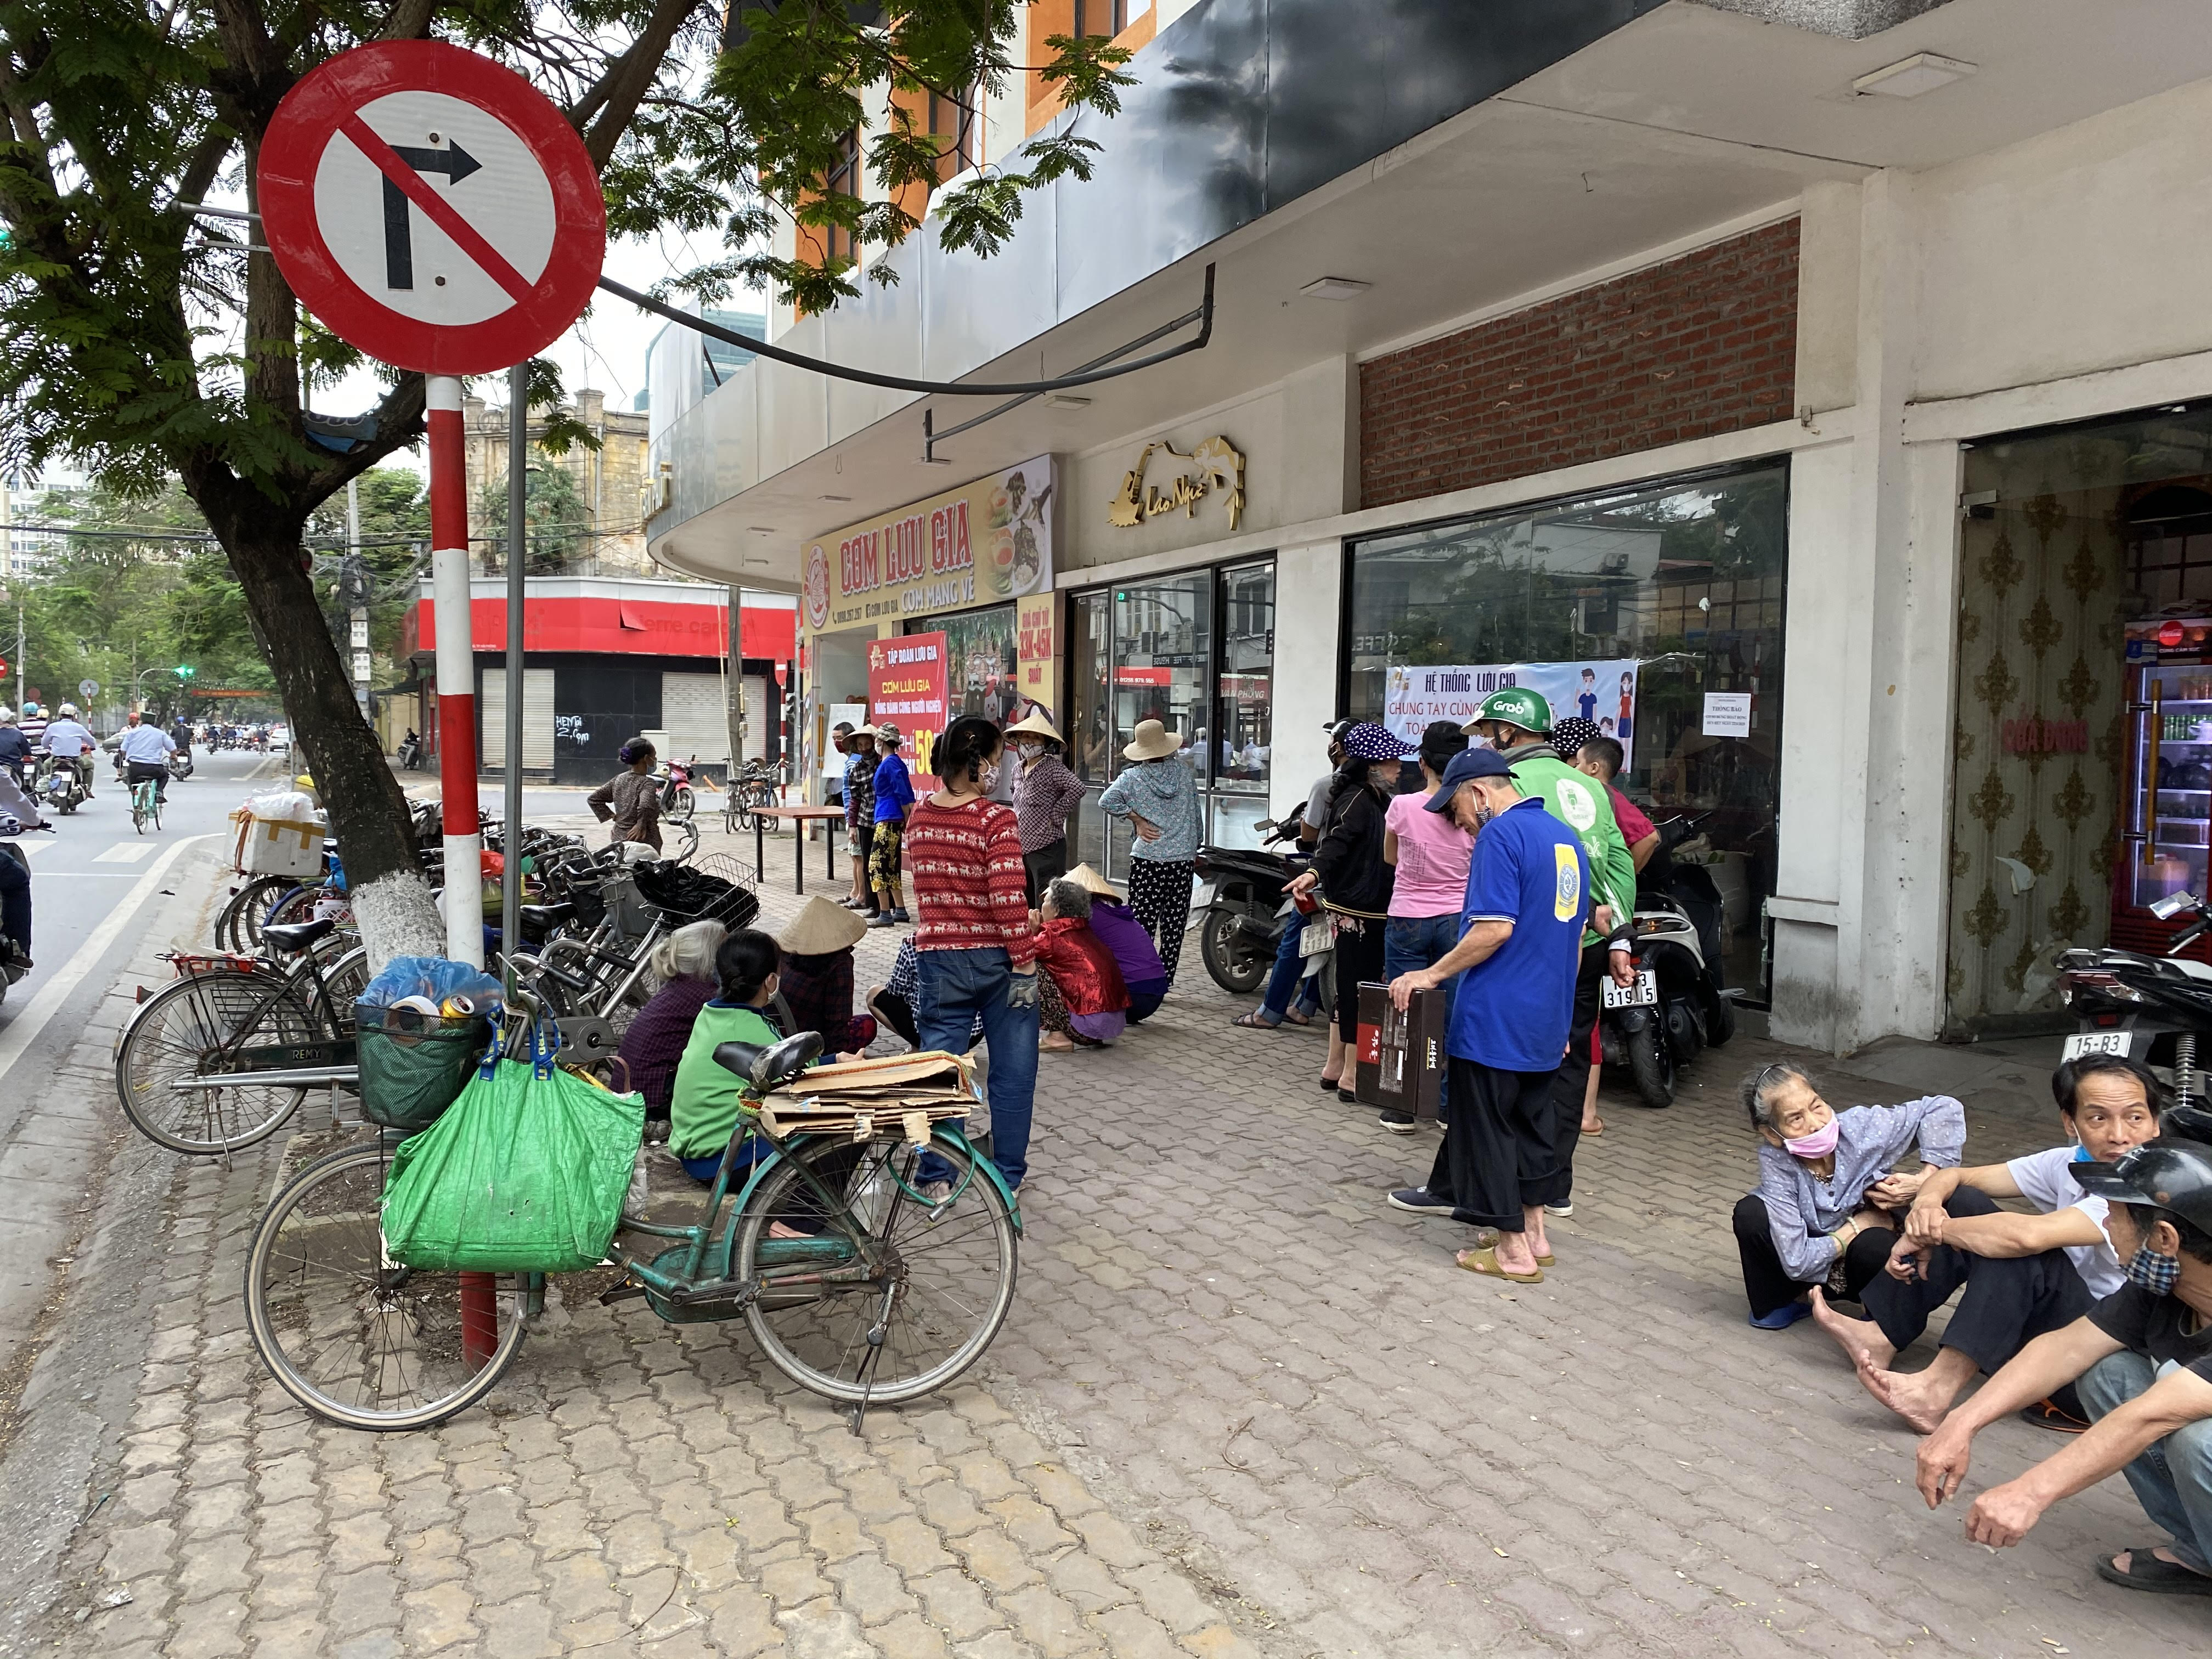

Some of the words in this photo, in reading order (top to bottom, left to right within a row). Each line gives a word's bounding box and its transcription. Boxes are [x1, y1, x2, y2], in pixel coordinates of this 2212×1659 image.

[840, 528, 880, 596] CƠM
[884, 514, 926, 585] LƯU
[931, 499, 973, 574] GIA
[901, 588, 923, 612] CƠM
[926, 580, 958, 608] MANG
[962, 568, 975, 601] VỀ
[887, 648, 898, 667] TẬP
[927, 645, 937, 660] GIA
[882, 680, 899, 694] CƠM
[917, 679, 930, 692] GIA
[1425, 671, 1436, 695] HỆ
[1440, 668, 1470, 692] THỐNG
[1477, 671, 1496, 692] LƯU
[1389, 702, 1424, 715] CHUNG
[1427, 702, 1448, 715] TAY
[1493, 701, 1525, 715] Grab
[293, 1048, 321, 1059] REMY
